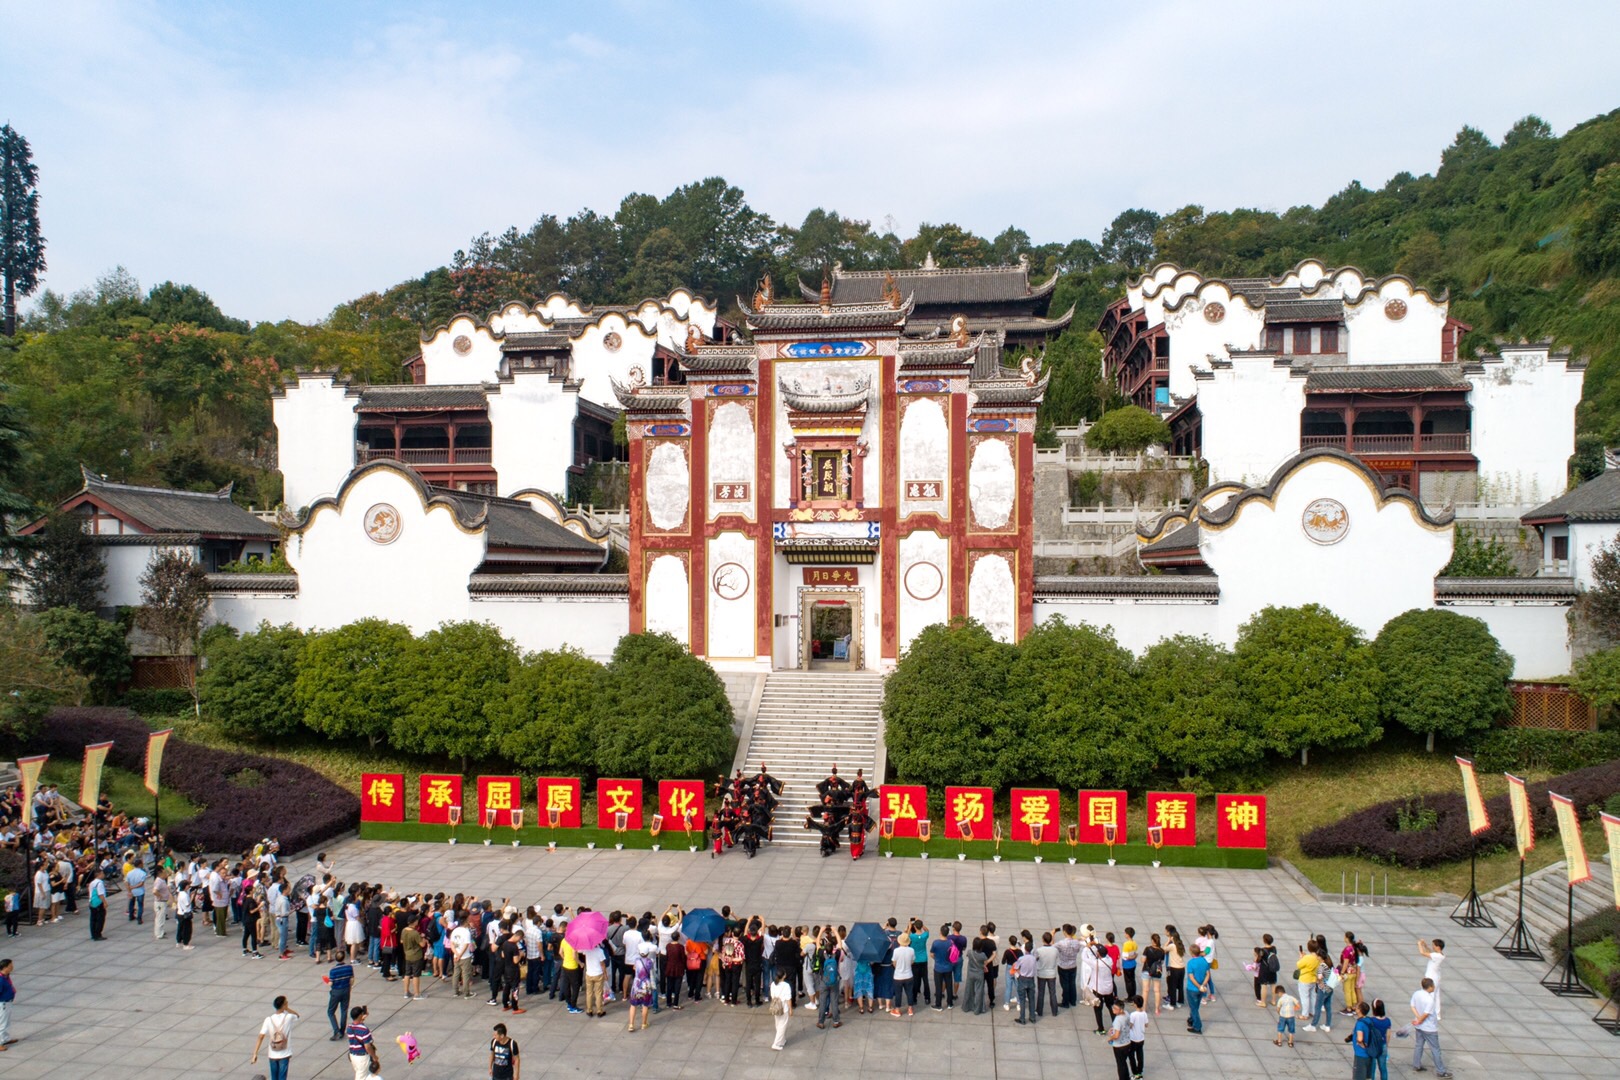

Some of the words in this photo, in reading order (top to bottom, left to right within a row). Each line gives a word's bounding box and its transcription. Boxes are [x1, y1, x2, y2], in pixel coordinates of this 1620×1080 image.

[367, 779, 698, 817] 传承屈原文化
[886, 792, 1259, 832] 弘扬爱国精神
